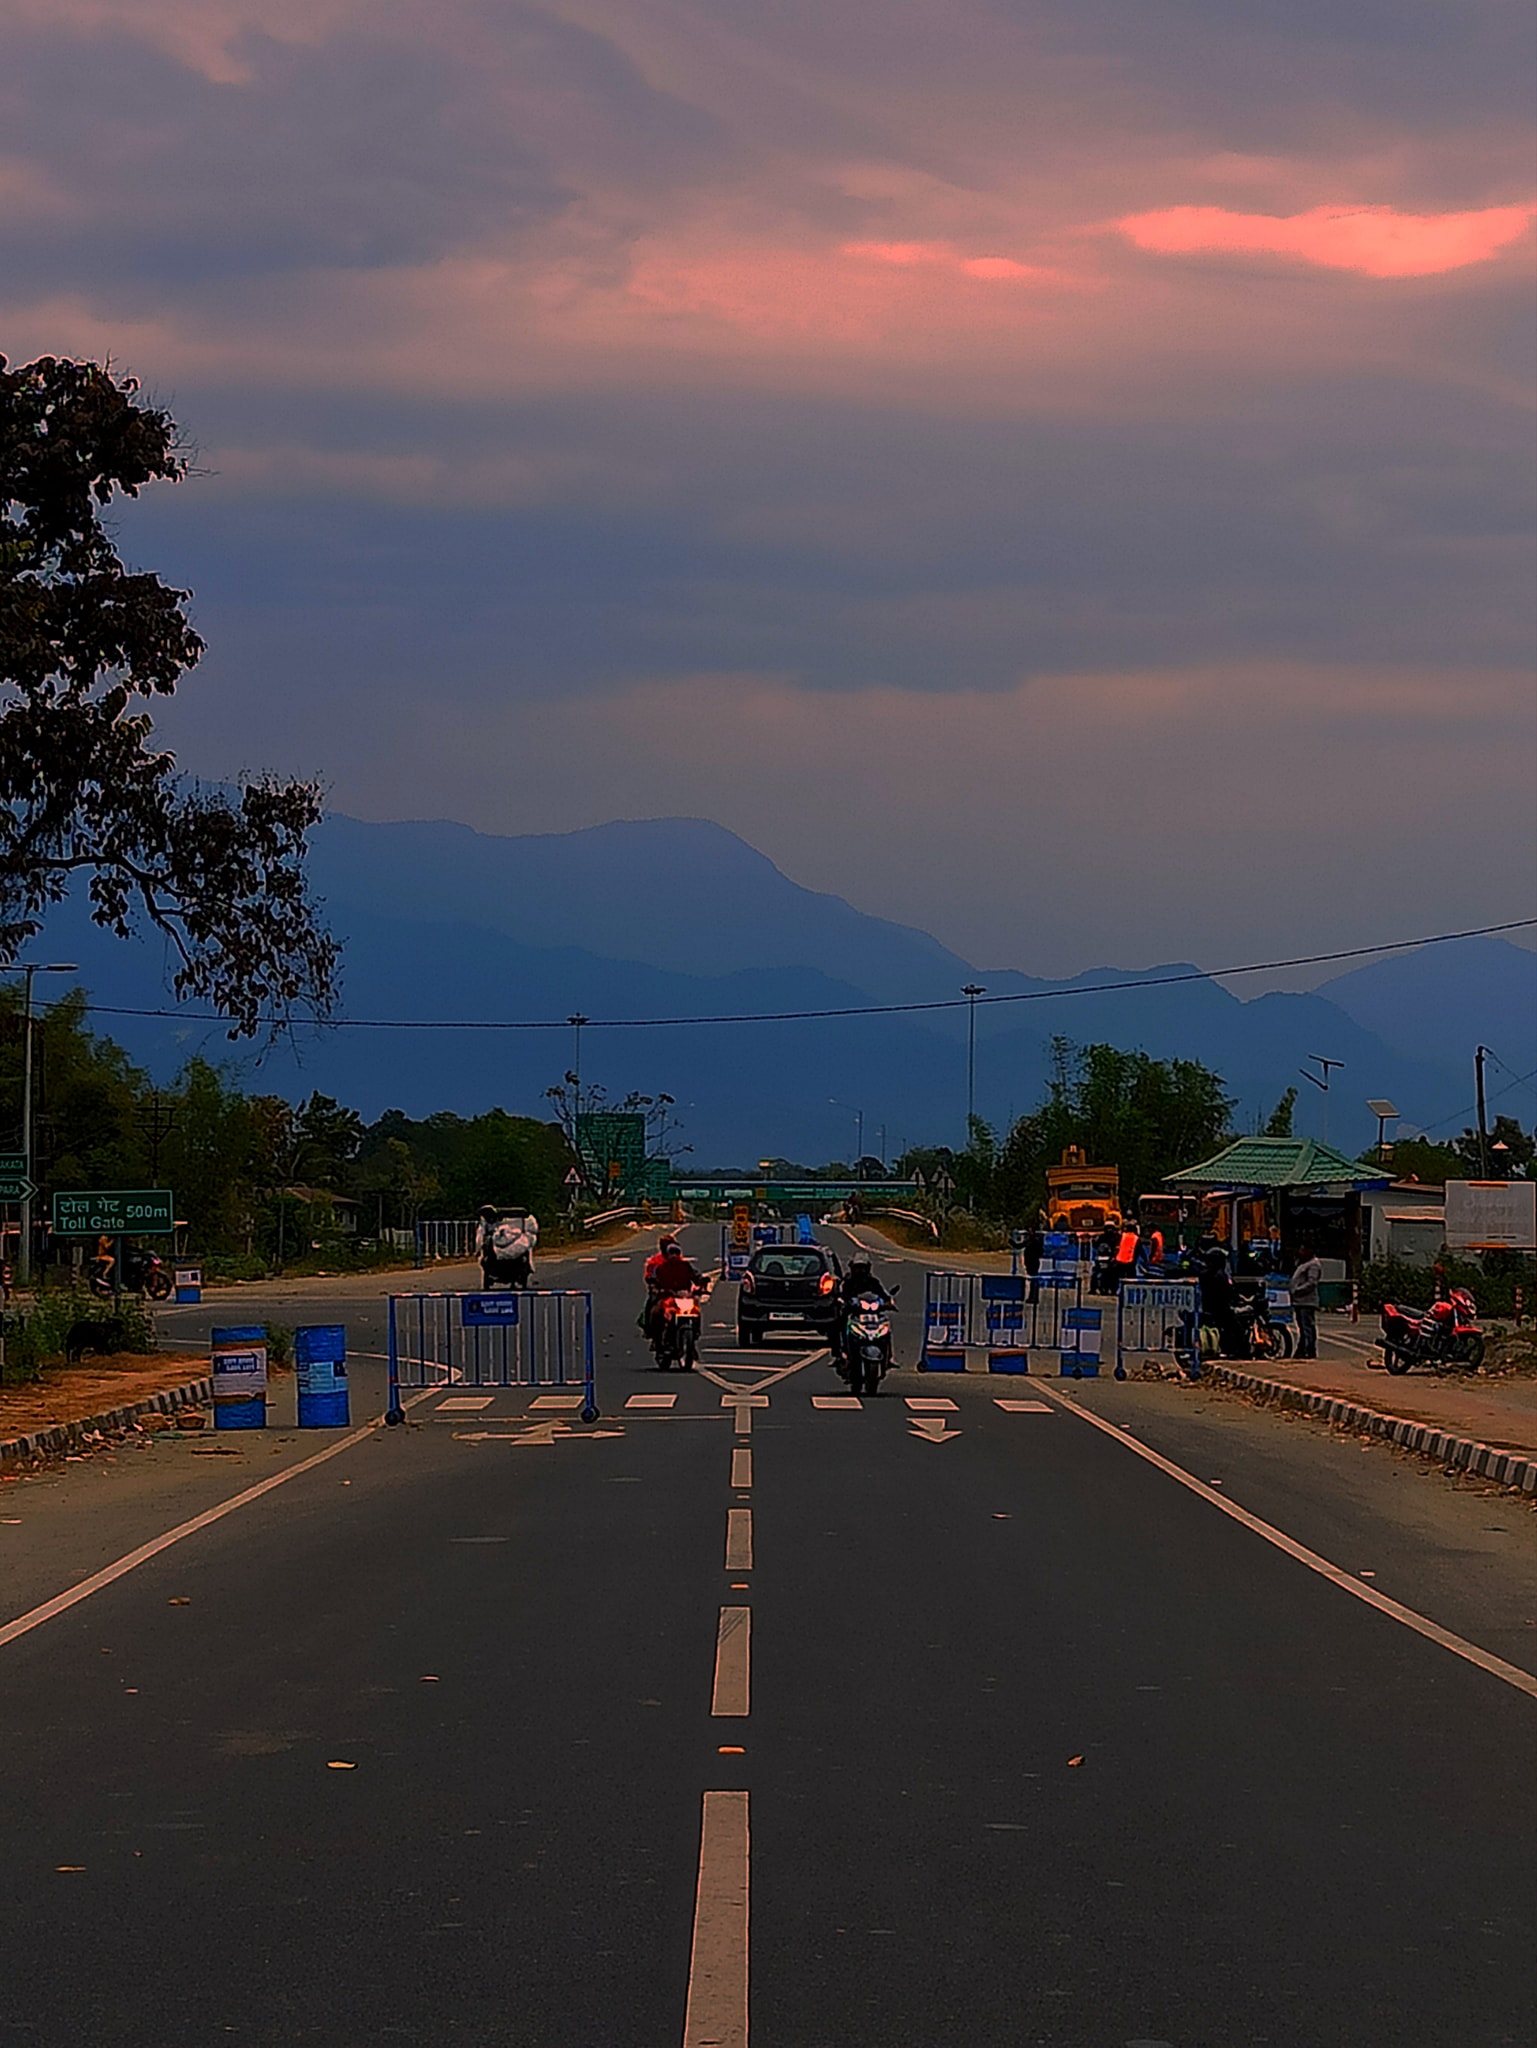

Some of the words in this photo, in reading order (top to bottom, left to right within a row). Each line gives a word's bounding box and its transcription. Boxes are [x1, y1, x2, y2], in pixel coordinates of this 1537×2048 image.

[59, 1196, 90, 1213] टोल
[96, 1196, 121, 1212] गेट
[126, 1204, 168, 1219] 500m
[59, 1216, 87, 1229] Toll
[90, 1215, 125, 1229] Gate
[1152, 1288, 1193, 1306] TRAFFIC
